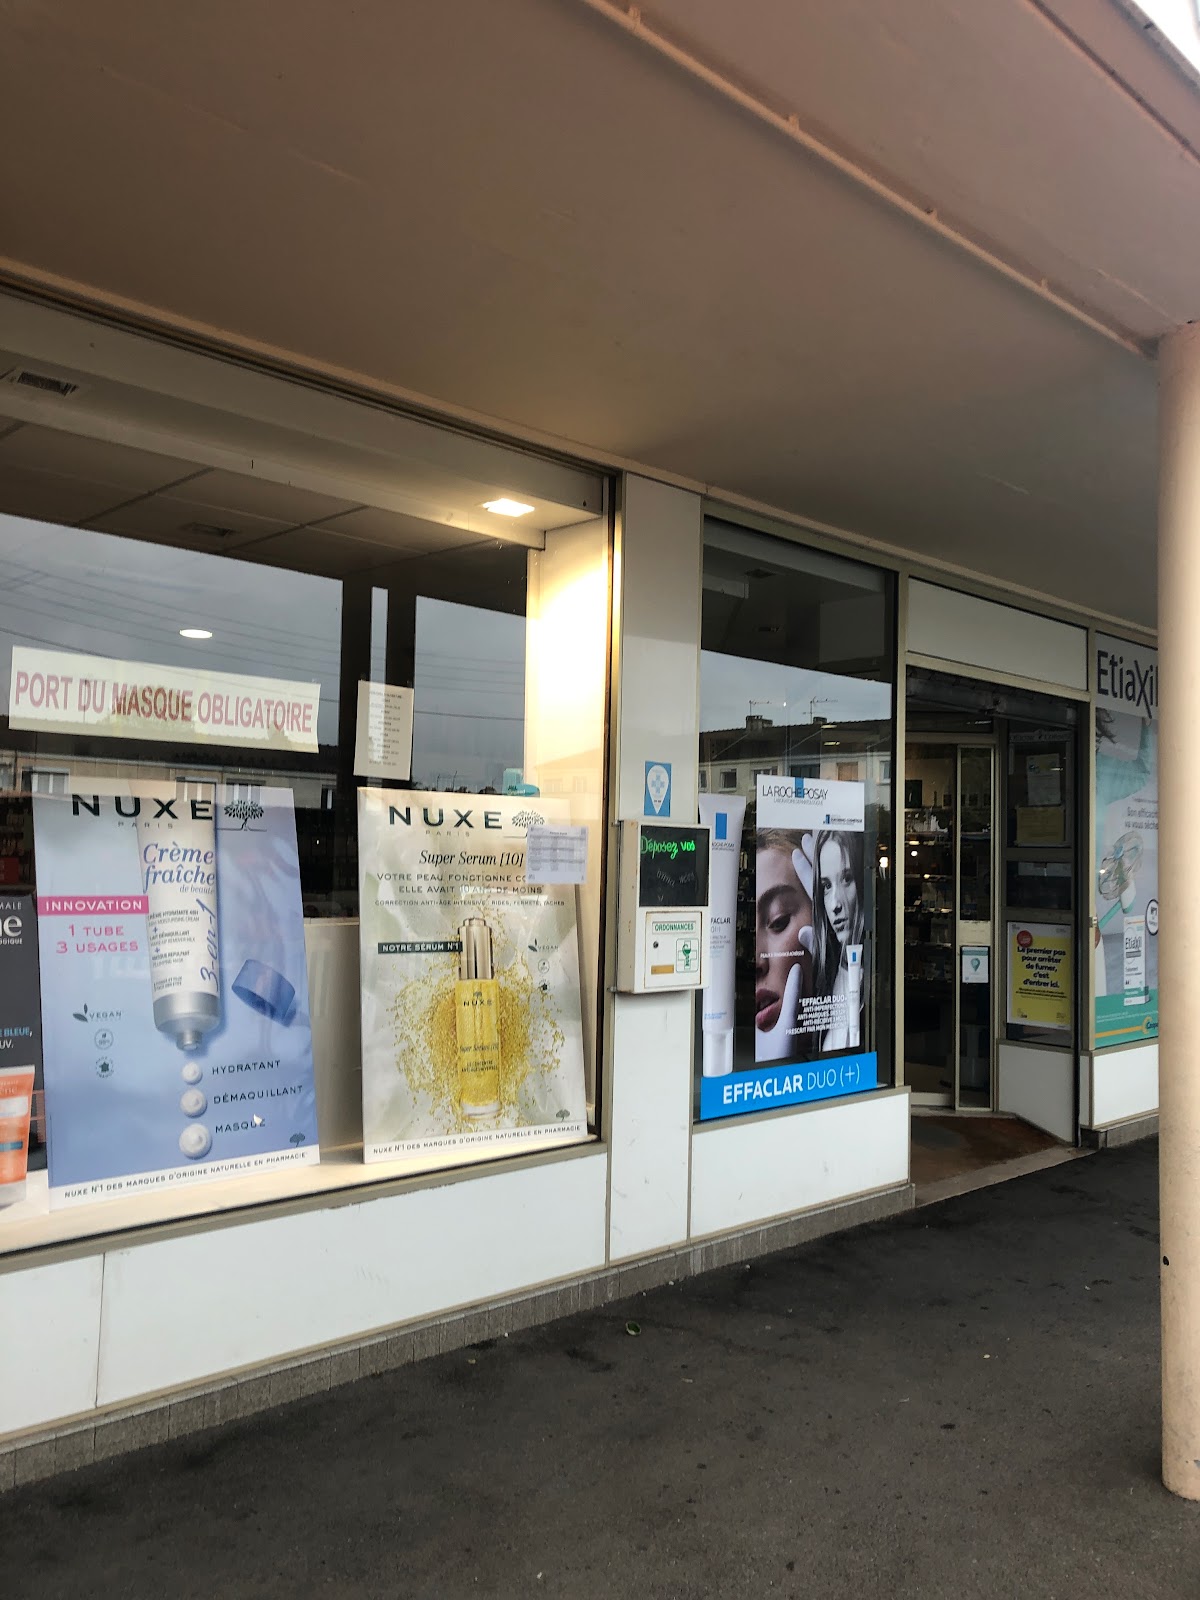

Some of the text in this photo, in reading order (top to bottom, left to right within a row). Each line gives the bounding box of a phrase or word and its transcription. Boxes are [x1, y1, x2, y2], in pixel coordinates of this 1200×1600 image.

[15, 671, 313, 733] PORT DU MASQUE OBLIGATOIRE
[72, 794, 213, 821] NUXE
[389, 805, 503, 830] NUXE
[118, 821, 174, 829] PARIS
[425, 829, 471, 838] PARIS
[143, 841, 214, 865] Crème
[681, 840, 696, 852] vos
[419, 849, 524, 868] Super Serum [10]
[143, 864, 215, 895] fraîche
[377, 873, 412, 881] VOTRE
[416, 874, 443, 882] PEAU
[448, 874, 512, 882] FONCTIONNE
[399, 885, 423, 894] ELLE
[427, 886, 455, 894] AVAIT
[512, 886, 543, 894] MOINS
[45, 899, 143, 912] INNOVATION
[375, 899, 419, 907] CORRECTION
[68, 923, 124, 937] 1 TUBE
[655, 923, 694, 931] ORDONNANCES
[56, 940, 139, 954] 3 USAGES
[382, 943, 412, 952] NOTRE
[415, 942, 444, 951] SÉRUM
[89, 1010, 122, 1020] VEGAN
[212, 1059, 281, 1075] HYDRATANT
[723, 1062, 860, 1105] EFFACLAR DUO (+)
[213, 1085, 303, 1105] DÉMAQUILLANT
[215, 1119, 266, 1134] MASQUE
[374, 1146, 392, 1154] NUXE
[423, 1139, 456, 1148] MARQUES
[495, 1130, 532, 1140] NATURELLE
[544, 1125, 581, 1135] PHARMACIE
[64, 1188, 89, 1199] NUXE
[106, 1182, 123, 1192] DES
[126, 1175, 166, 1187] MARQUES
[168, 1169, 208, 1181] D'ORIGINE
[210, 1160, 251, 1174] NATURELLE
[254, 1158, 263, 1167] EN
[266, 1151, 306, 1164] PHARMACIE
